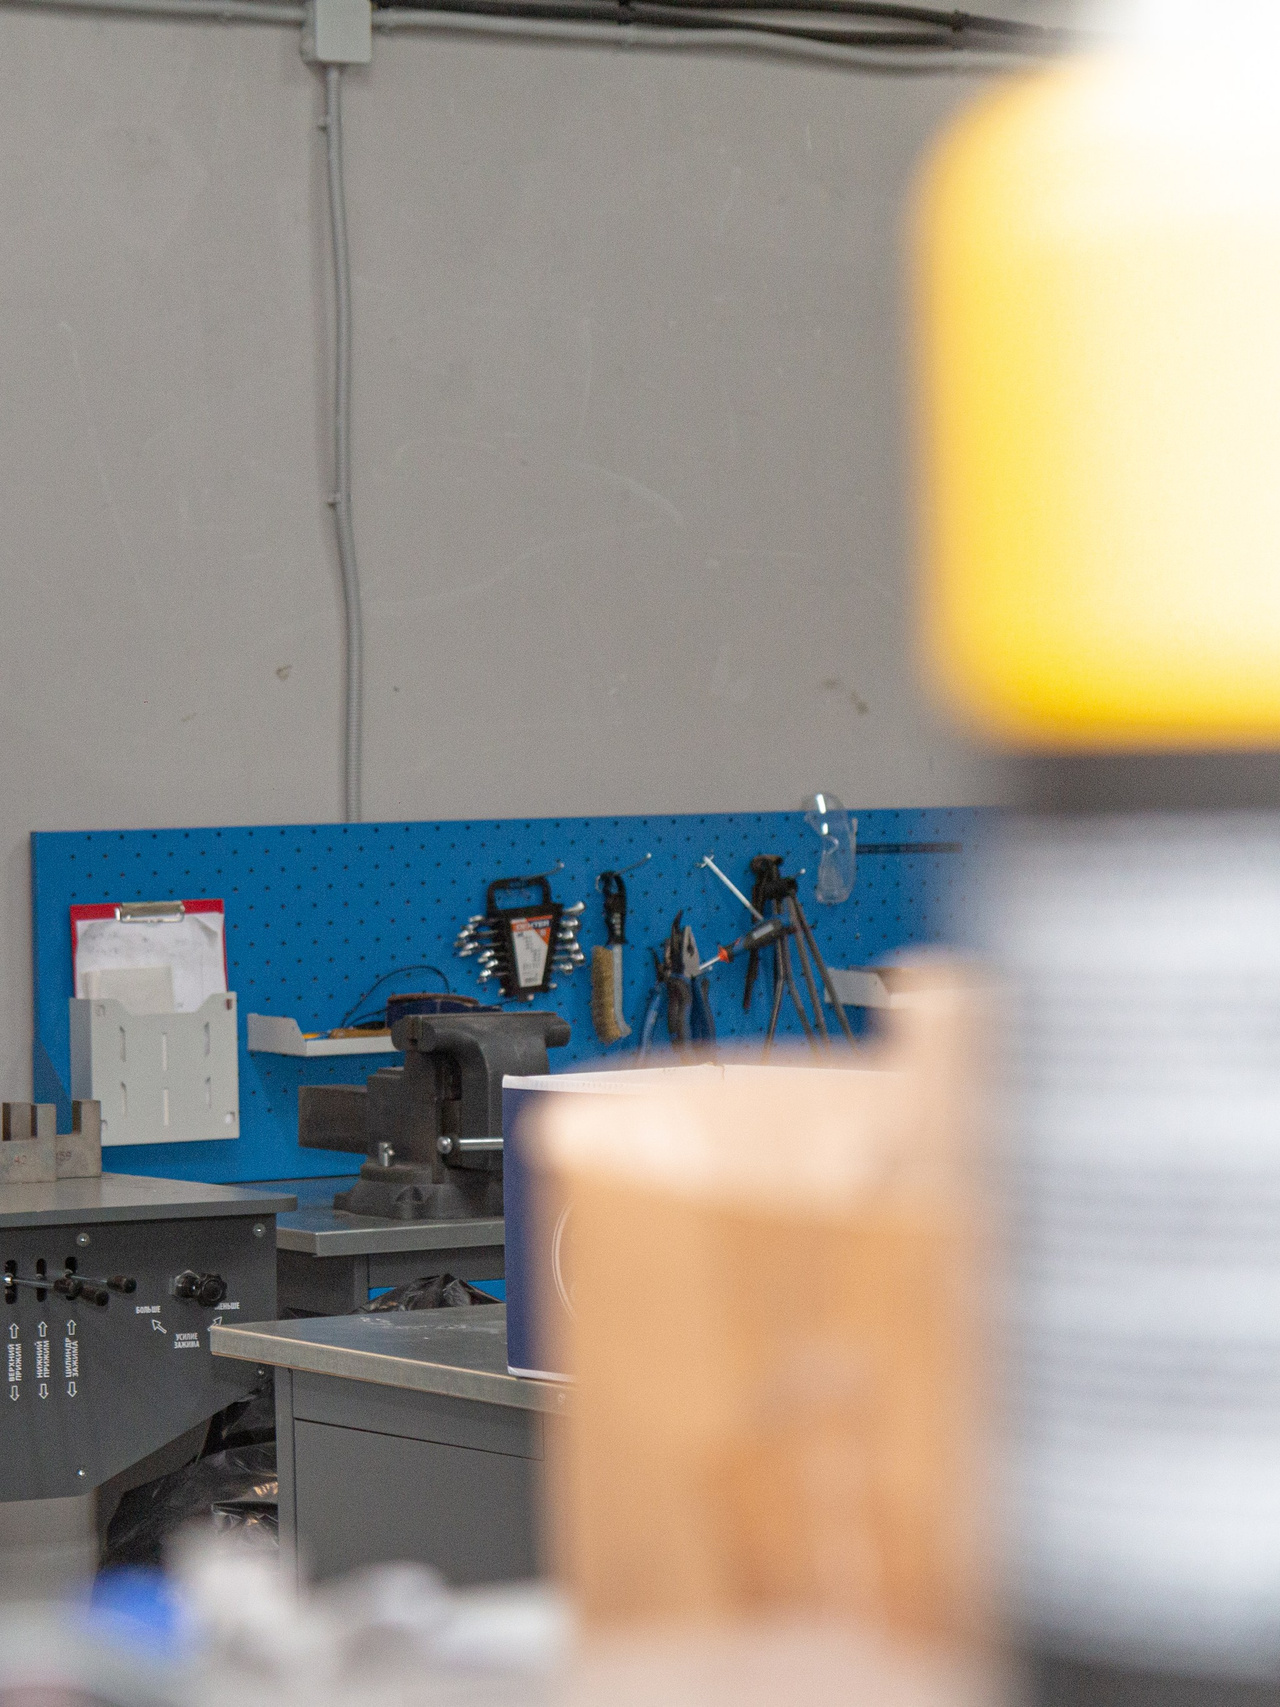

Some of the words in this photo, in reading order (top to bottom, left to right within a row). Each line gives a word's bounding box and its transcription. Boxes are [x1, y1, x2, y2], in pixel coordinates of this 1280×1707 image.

[135, 1305, 161, 1314] БОЛЬШЕ
[174, 1341, 200, 1349] ЗАЖИМА
[175, 1333, 198, 1341] УСИЛИЕ
[7, 1343, 15, 1382] ВЕРХНИЙ
[34, 1341, 43, 1378] НИЖНИЙ
[64, 1337, 72, 1378] ЦИЛИНДР
